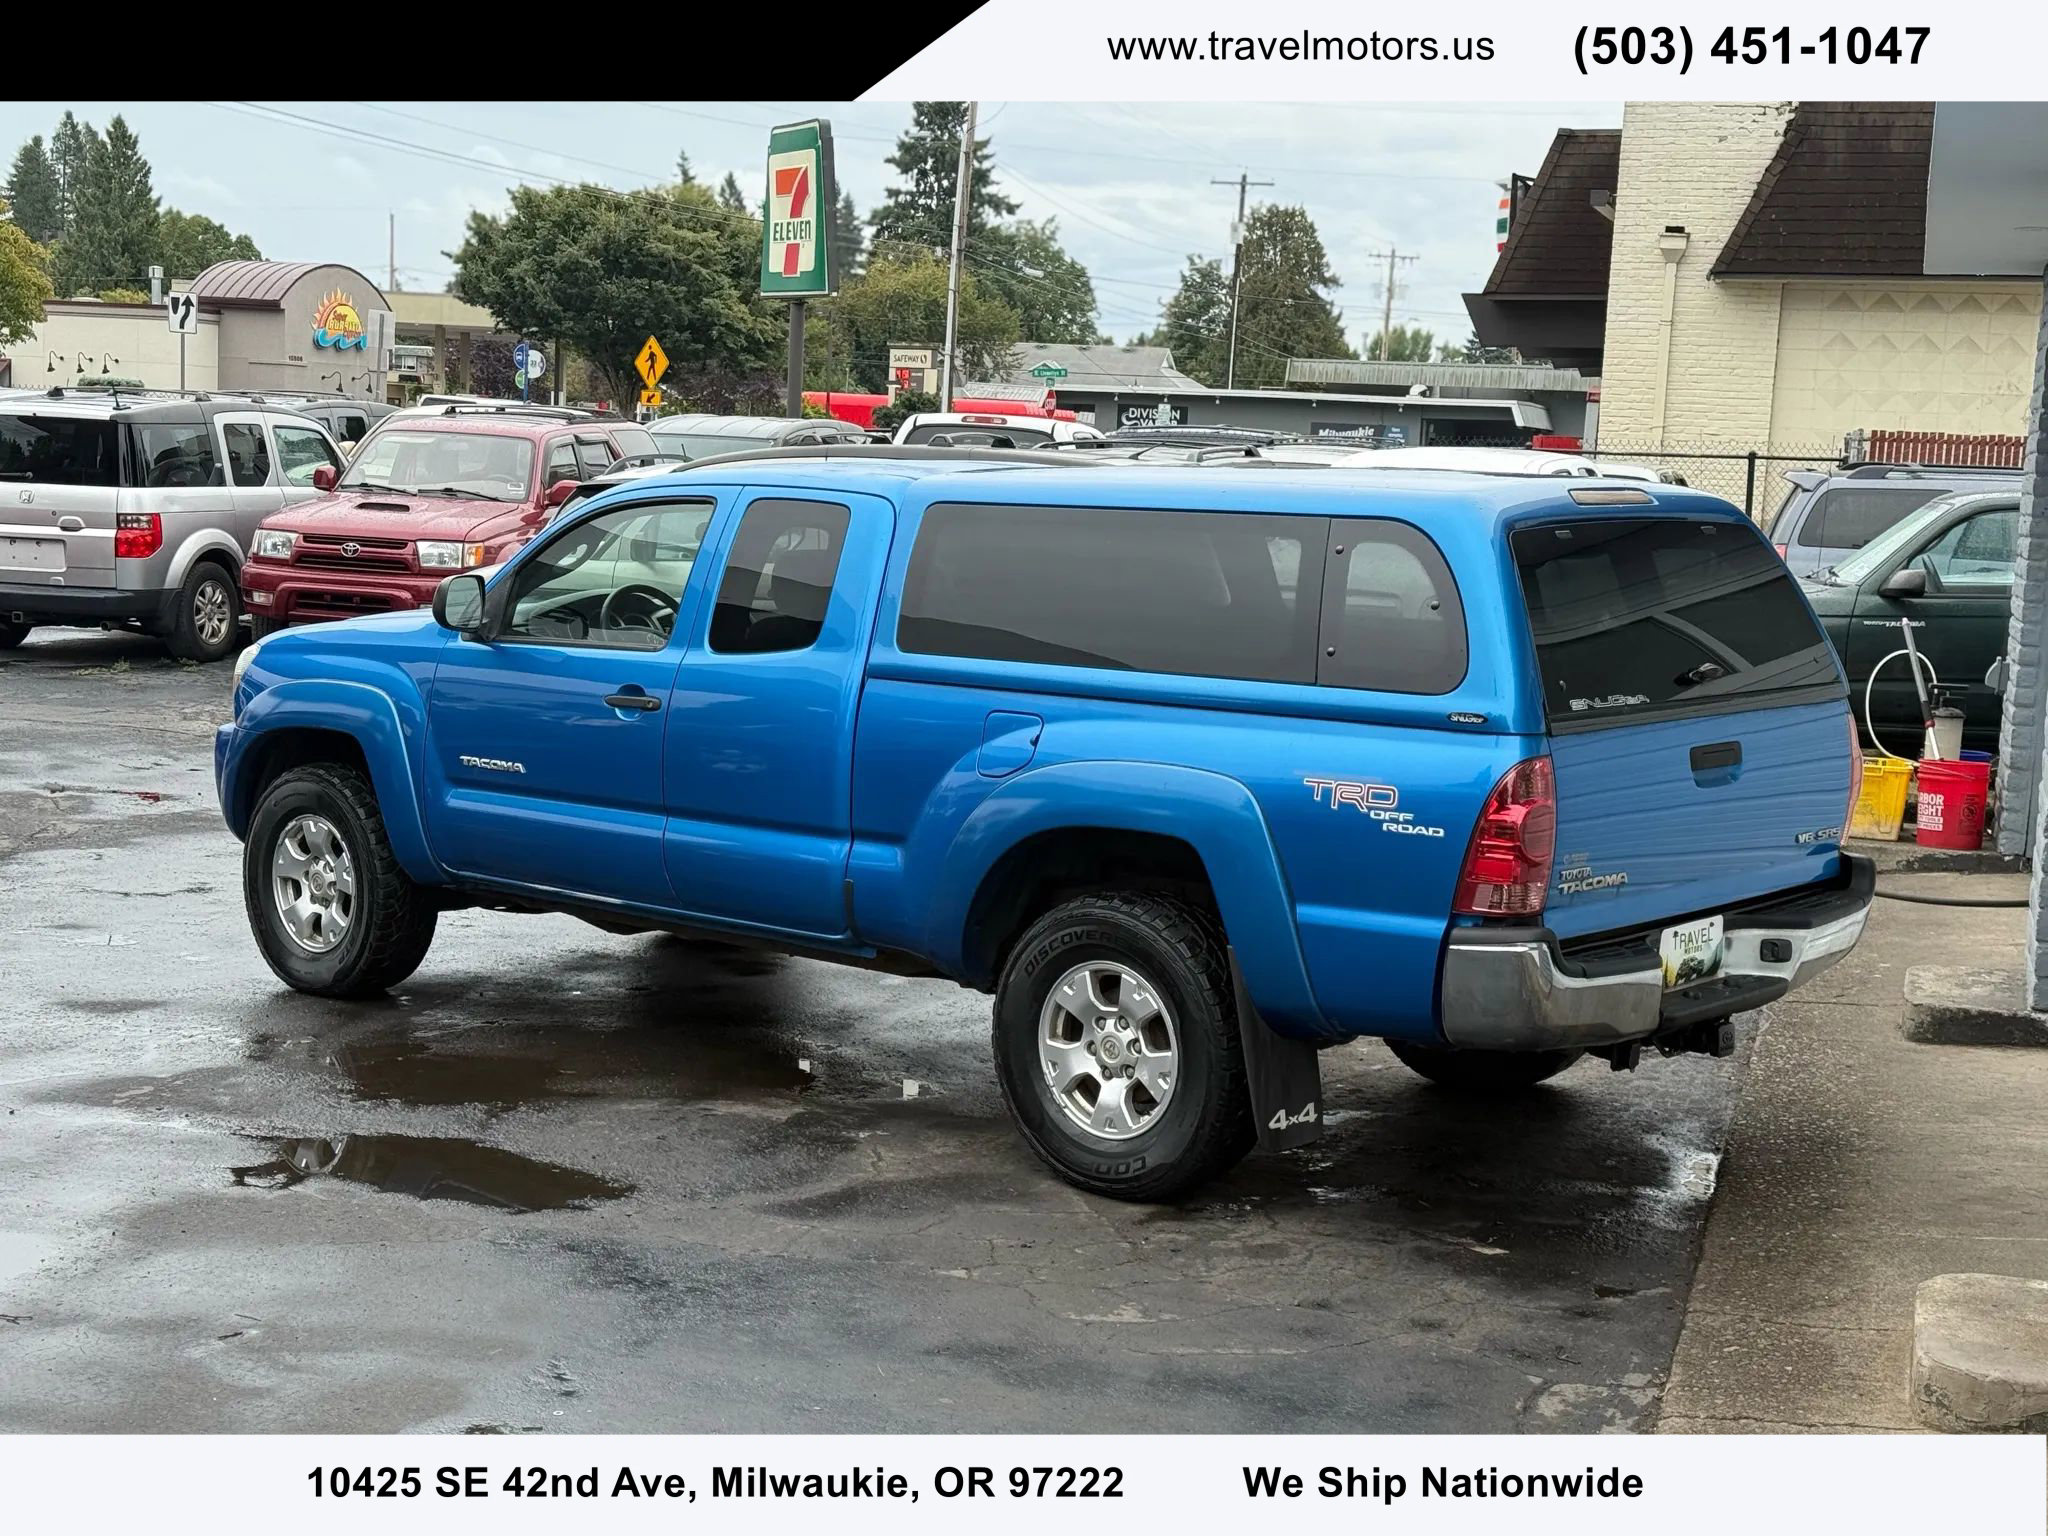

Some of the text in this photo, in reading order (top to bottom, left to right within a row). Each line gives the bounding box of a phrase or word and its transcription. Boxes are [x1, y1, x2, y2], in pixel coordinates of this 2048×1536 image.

[893, 354, 920, 363] SAFEWAY
[1128, 407, 1181, 420] DIVISN
[459, 755, 527, 774] TACOMA
[1304, 777, 1398, 813] TRD
[1369, 809, 1415, 822] OFF
[1382, 822, 1446, 838] ROAD
[1797, 832, 1813, 844] V6
[1560, 867, 1593, 881] TOYOTA
[1558, 872, 1629, 895] TACOMA
[1268, 1101, 1319, 1130] 4x4
